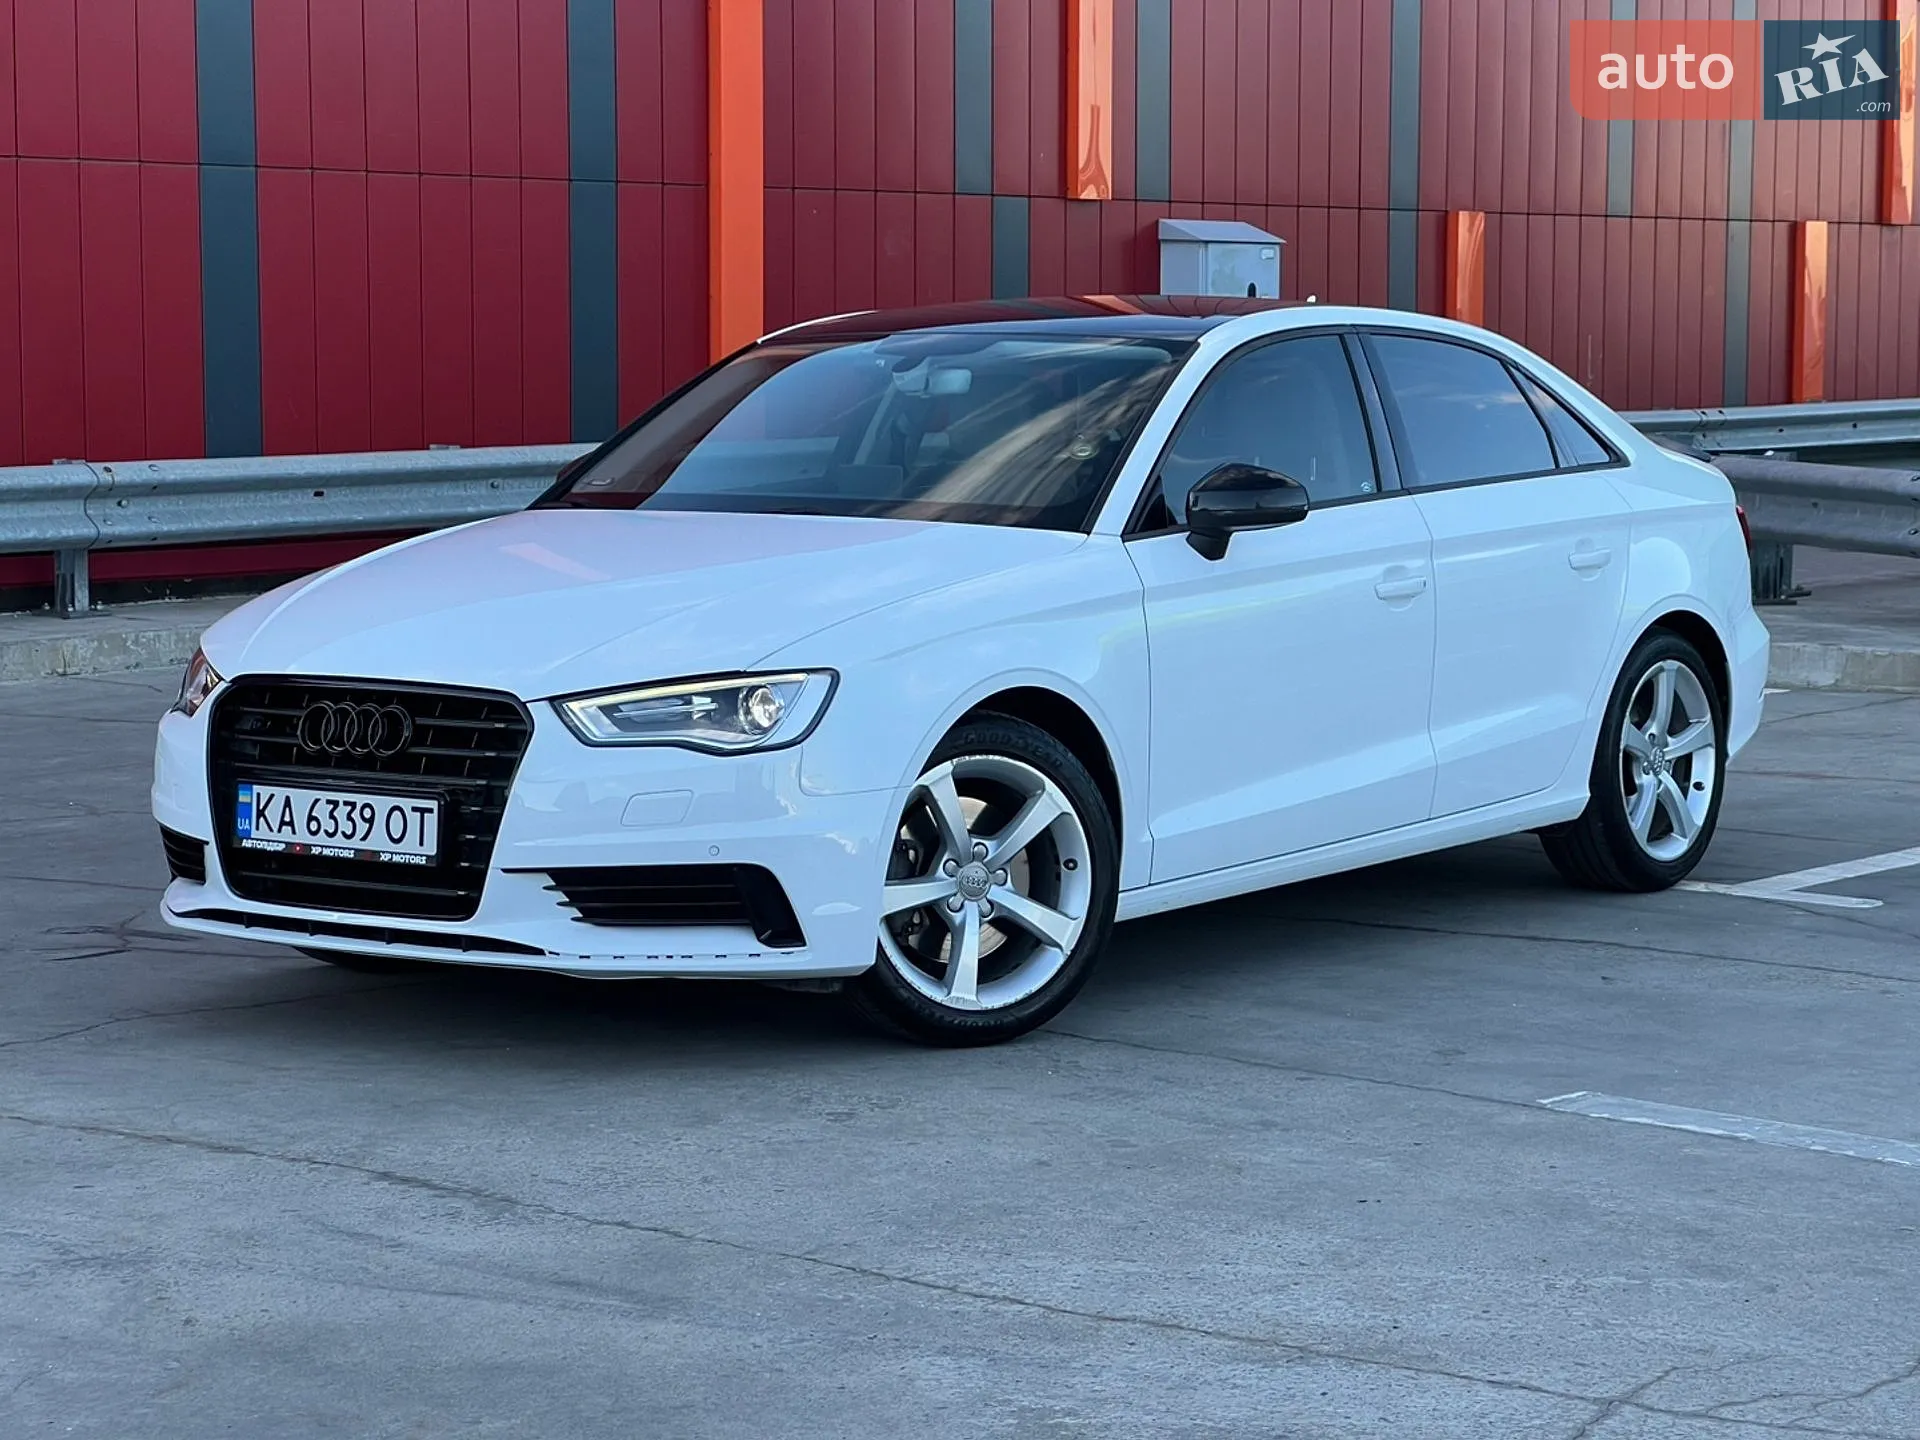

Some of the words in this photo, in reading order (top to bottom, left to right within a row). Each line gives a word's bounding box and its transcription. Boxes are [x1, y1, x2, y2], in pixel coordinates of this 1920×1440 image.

[237, 817, 251, 830] UA
[255, 792, 297, 836] KA
[306, 798, 376, 842] 6339
[385, 804, 434, 847] OT
